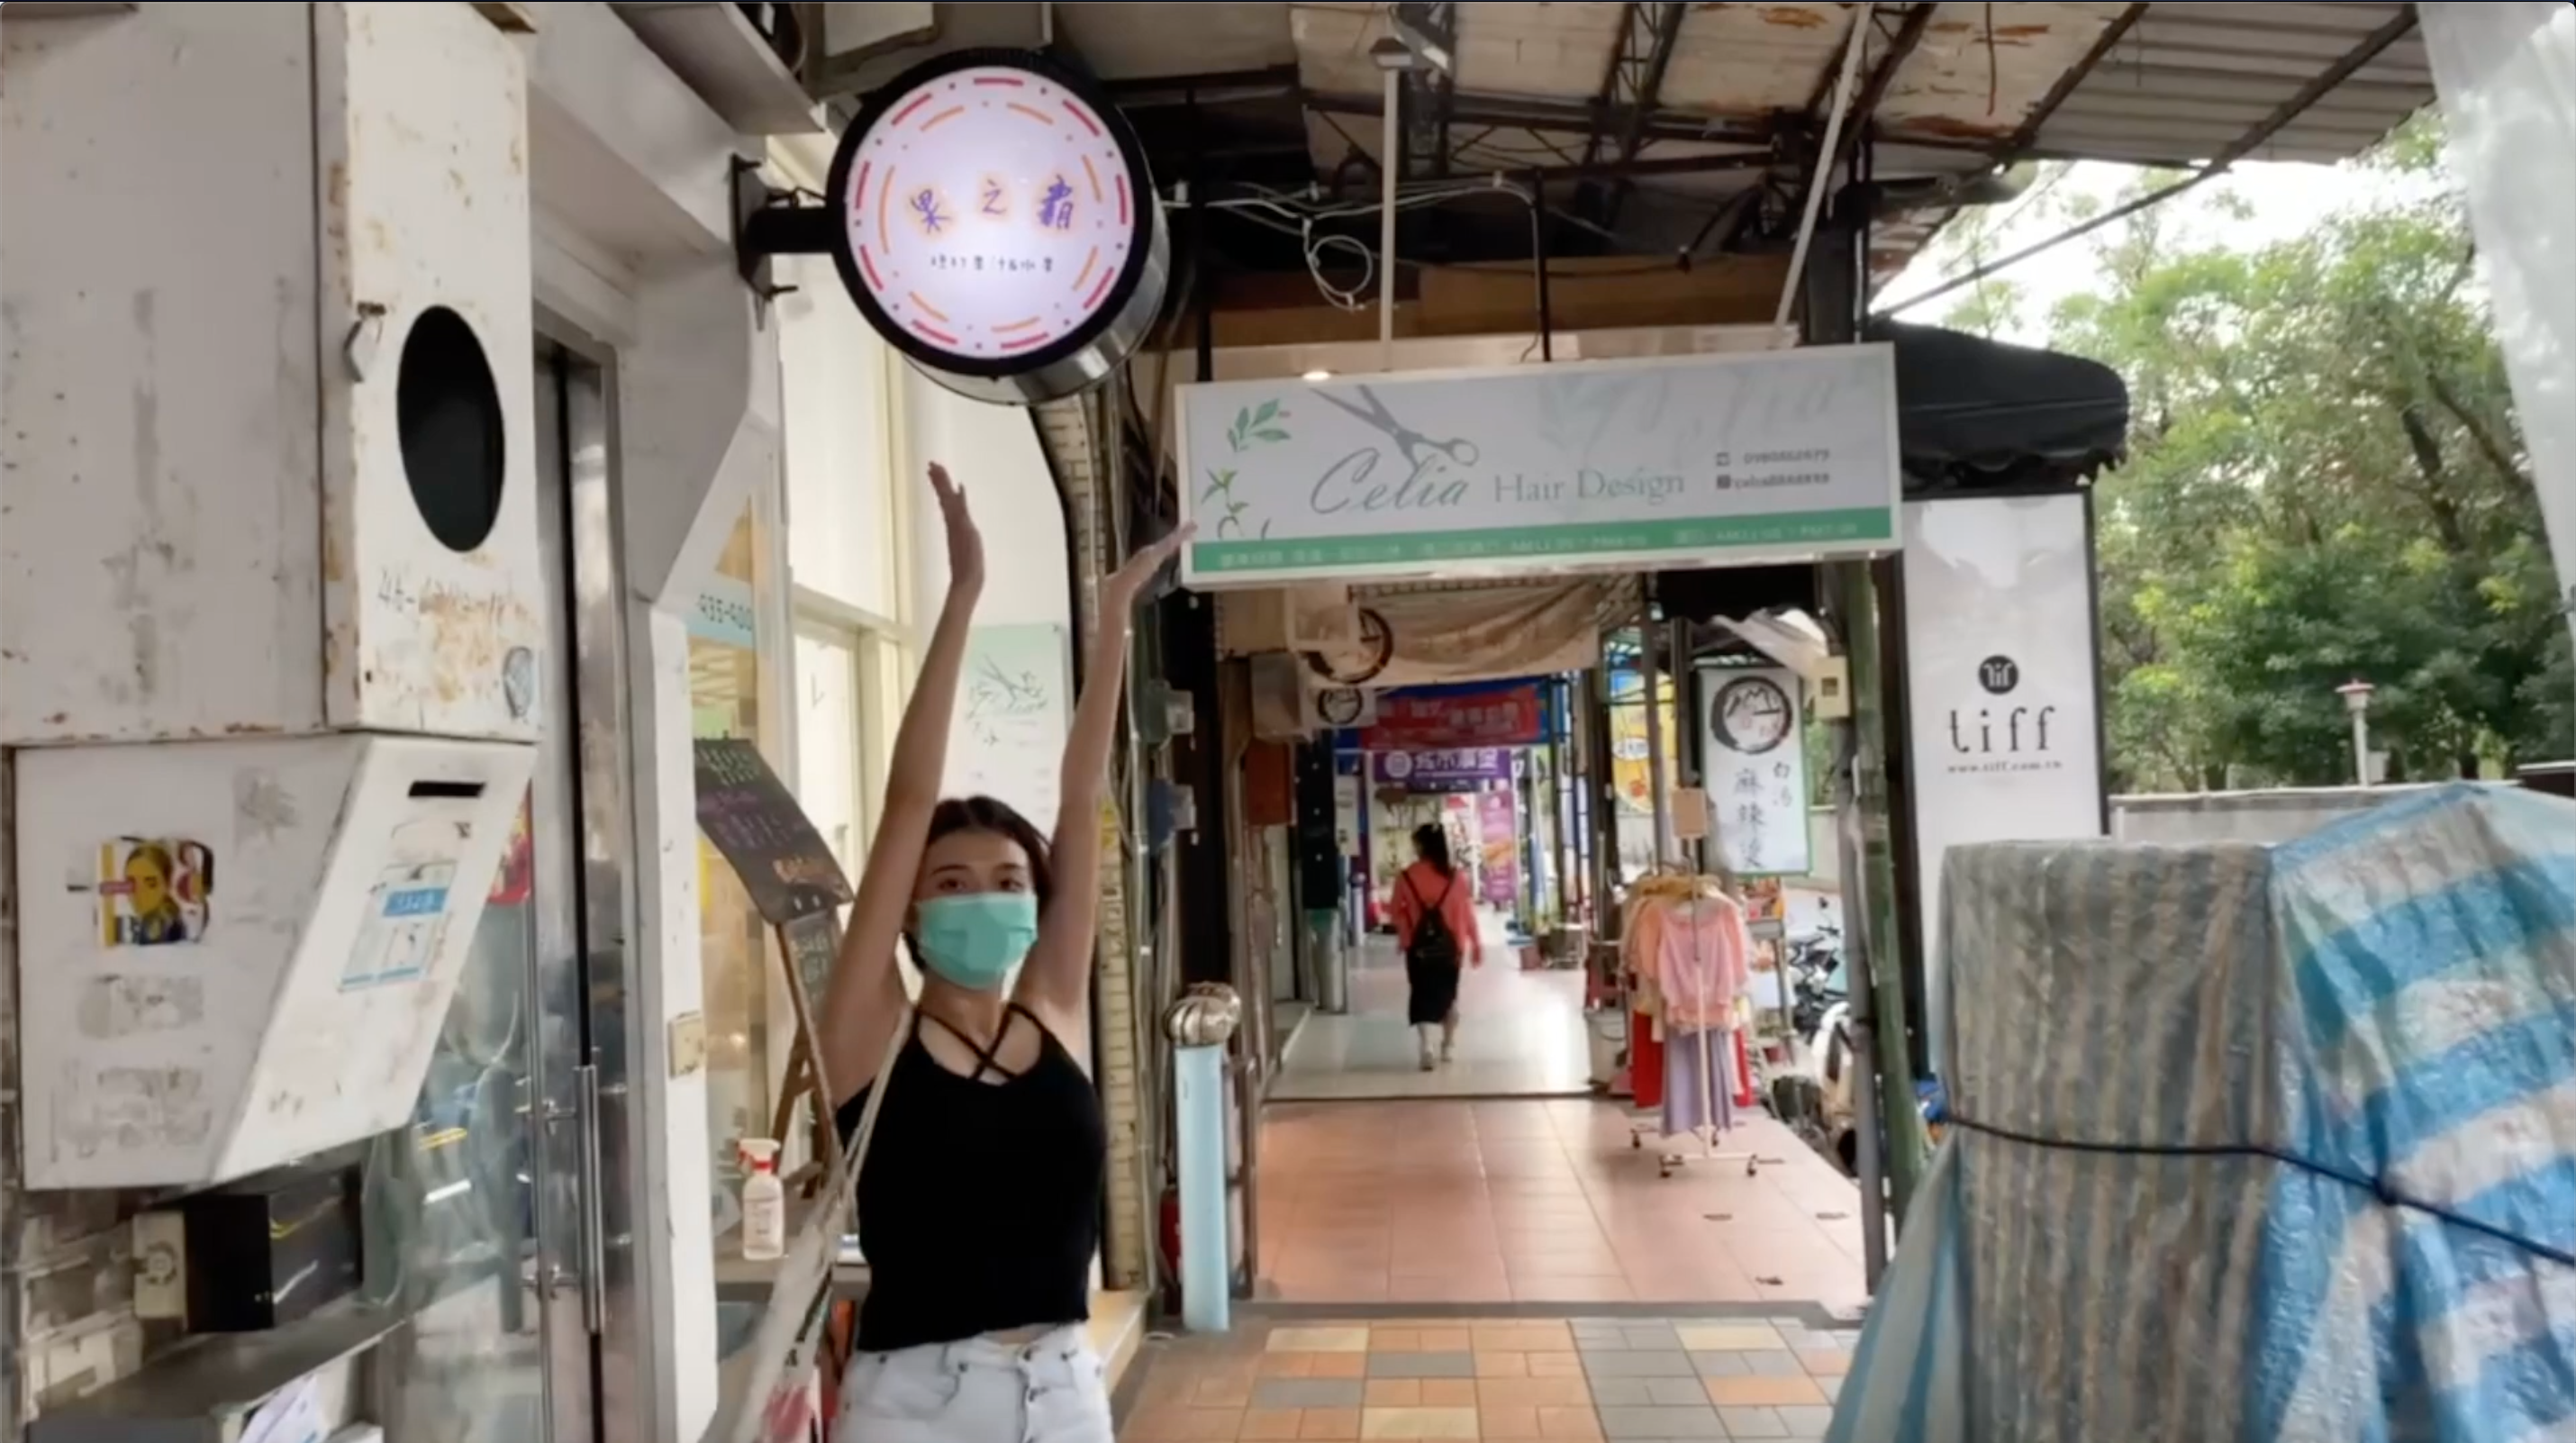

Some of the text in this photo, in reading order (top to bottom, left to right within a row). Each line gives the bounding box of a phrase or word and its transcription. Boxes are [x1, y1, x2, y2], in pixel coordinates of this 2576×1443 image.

[1310, 446, 1685, 514] Celia Hair Design
[1949, 704, 2056, 754] tiff
